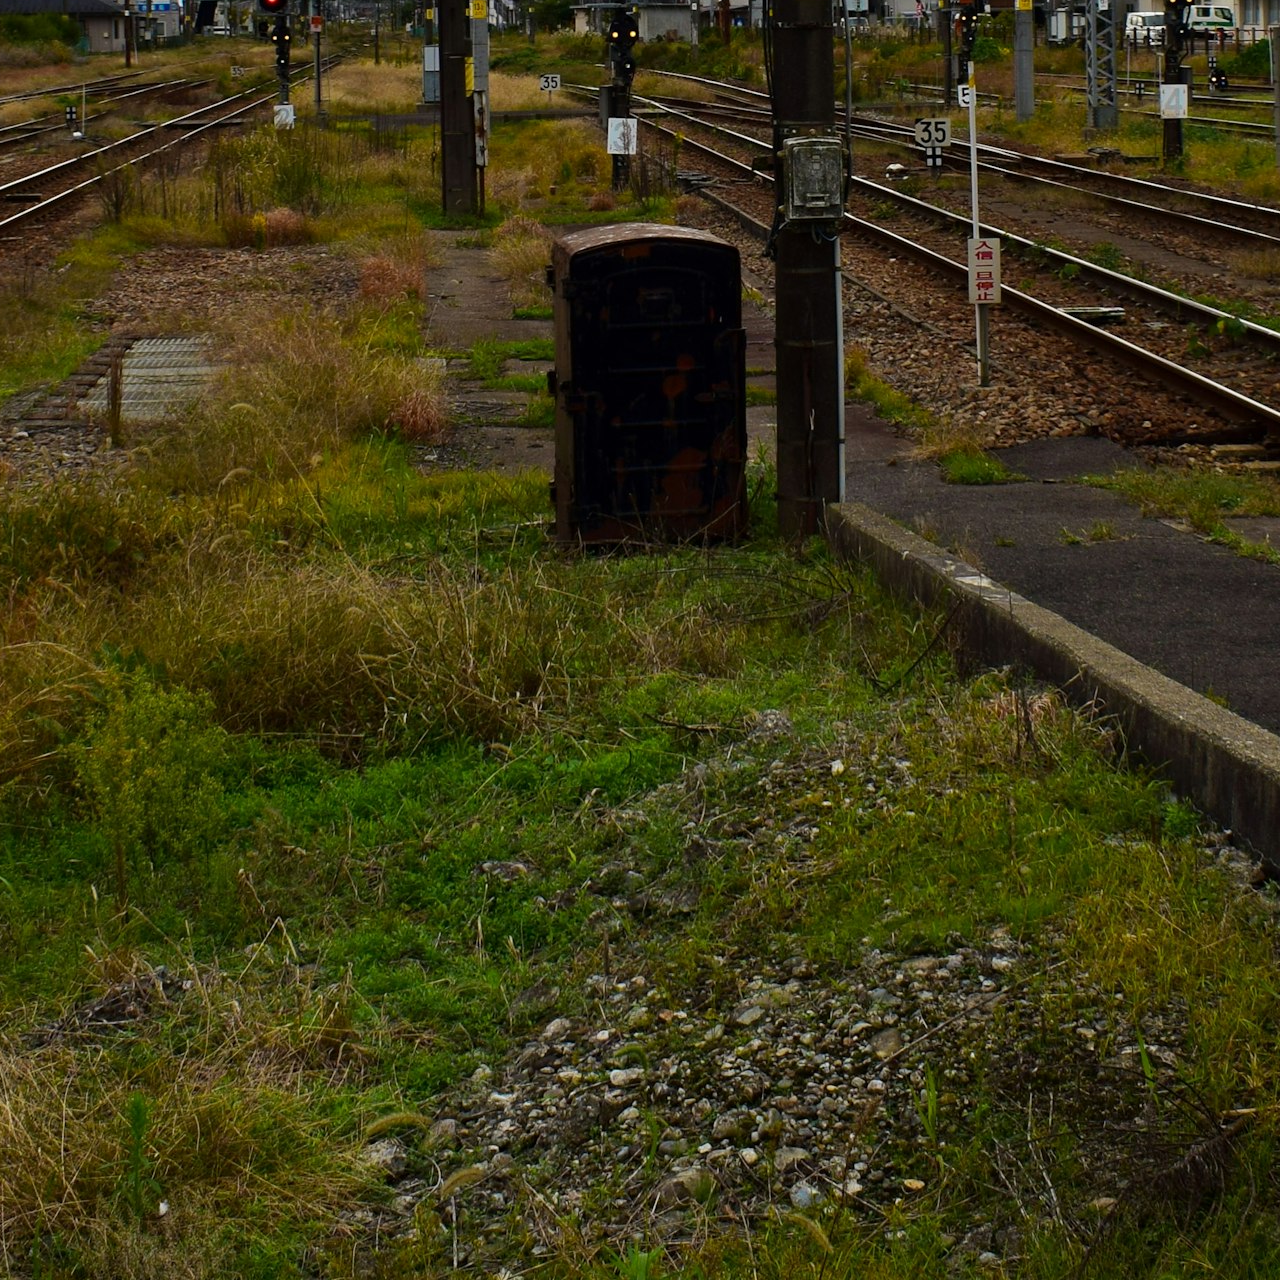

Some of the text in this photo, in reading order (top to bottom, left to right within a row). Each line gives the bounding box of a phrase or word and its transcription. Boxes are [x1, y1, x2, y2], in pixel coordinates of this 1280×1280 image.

[543, 76, 558, 89] 35
[920, 121, 947, 144] 35
[974, 240, 995, 302] 入信一旦停止
